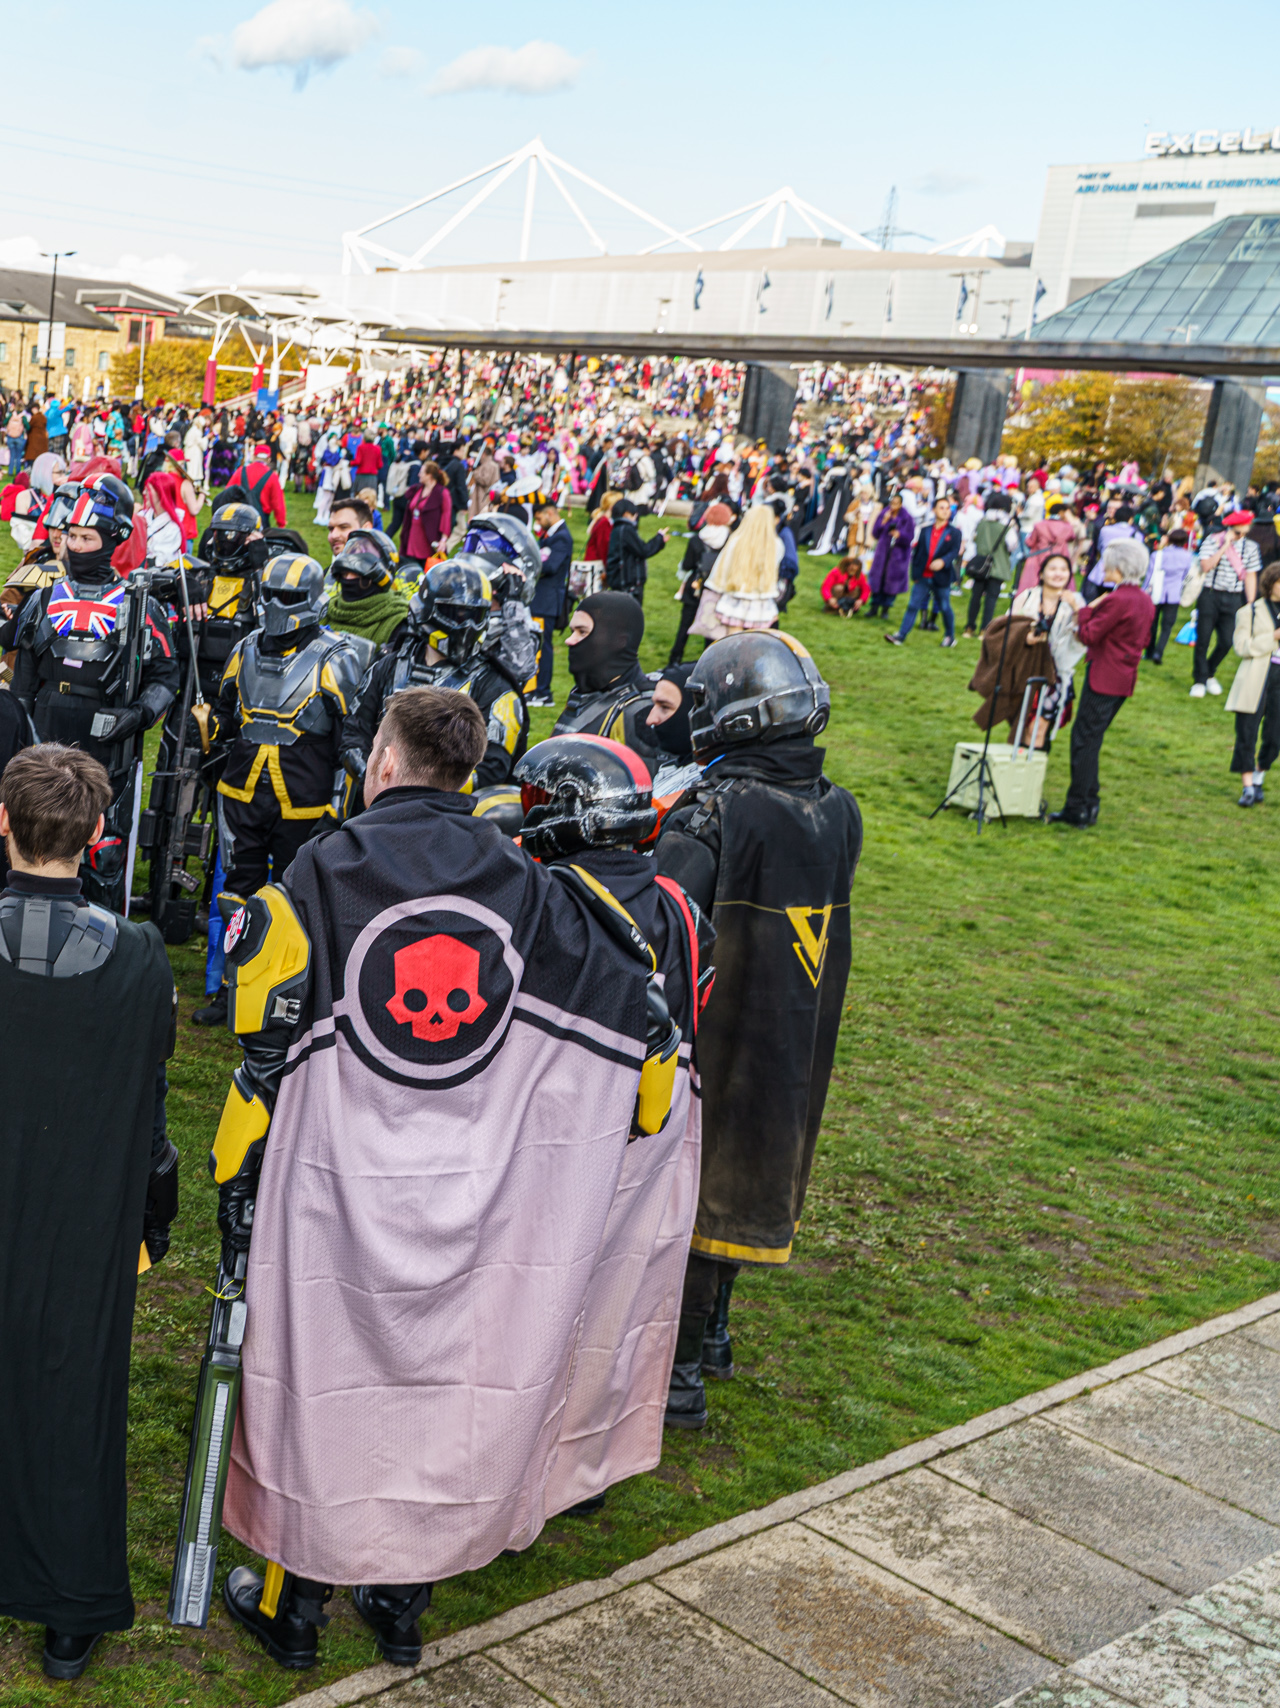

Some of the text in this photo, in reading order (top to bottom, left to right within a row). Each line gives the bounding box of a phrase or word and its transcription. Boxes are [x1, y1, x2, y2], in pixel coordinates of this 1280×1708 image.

[1075, 183, 1100, 194] ABU
[1102, 182, 1139, 193] DHABI
[1142, 180, 1202, 191] NATIONAL
